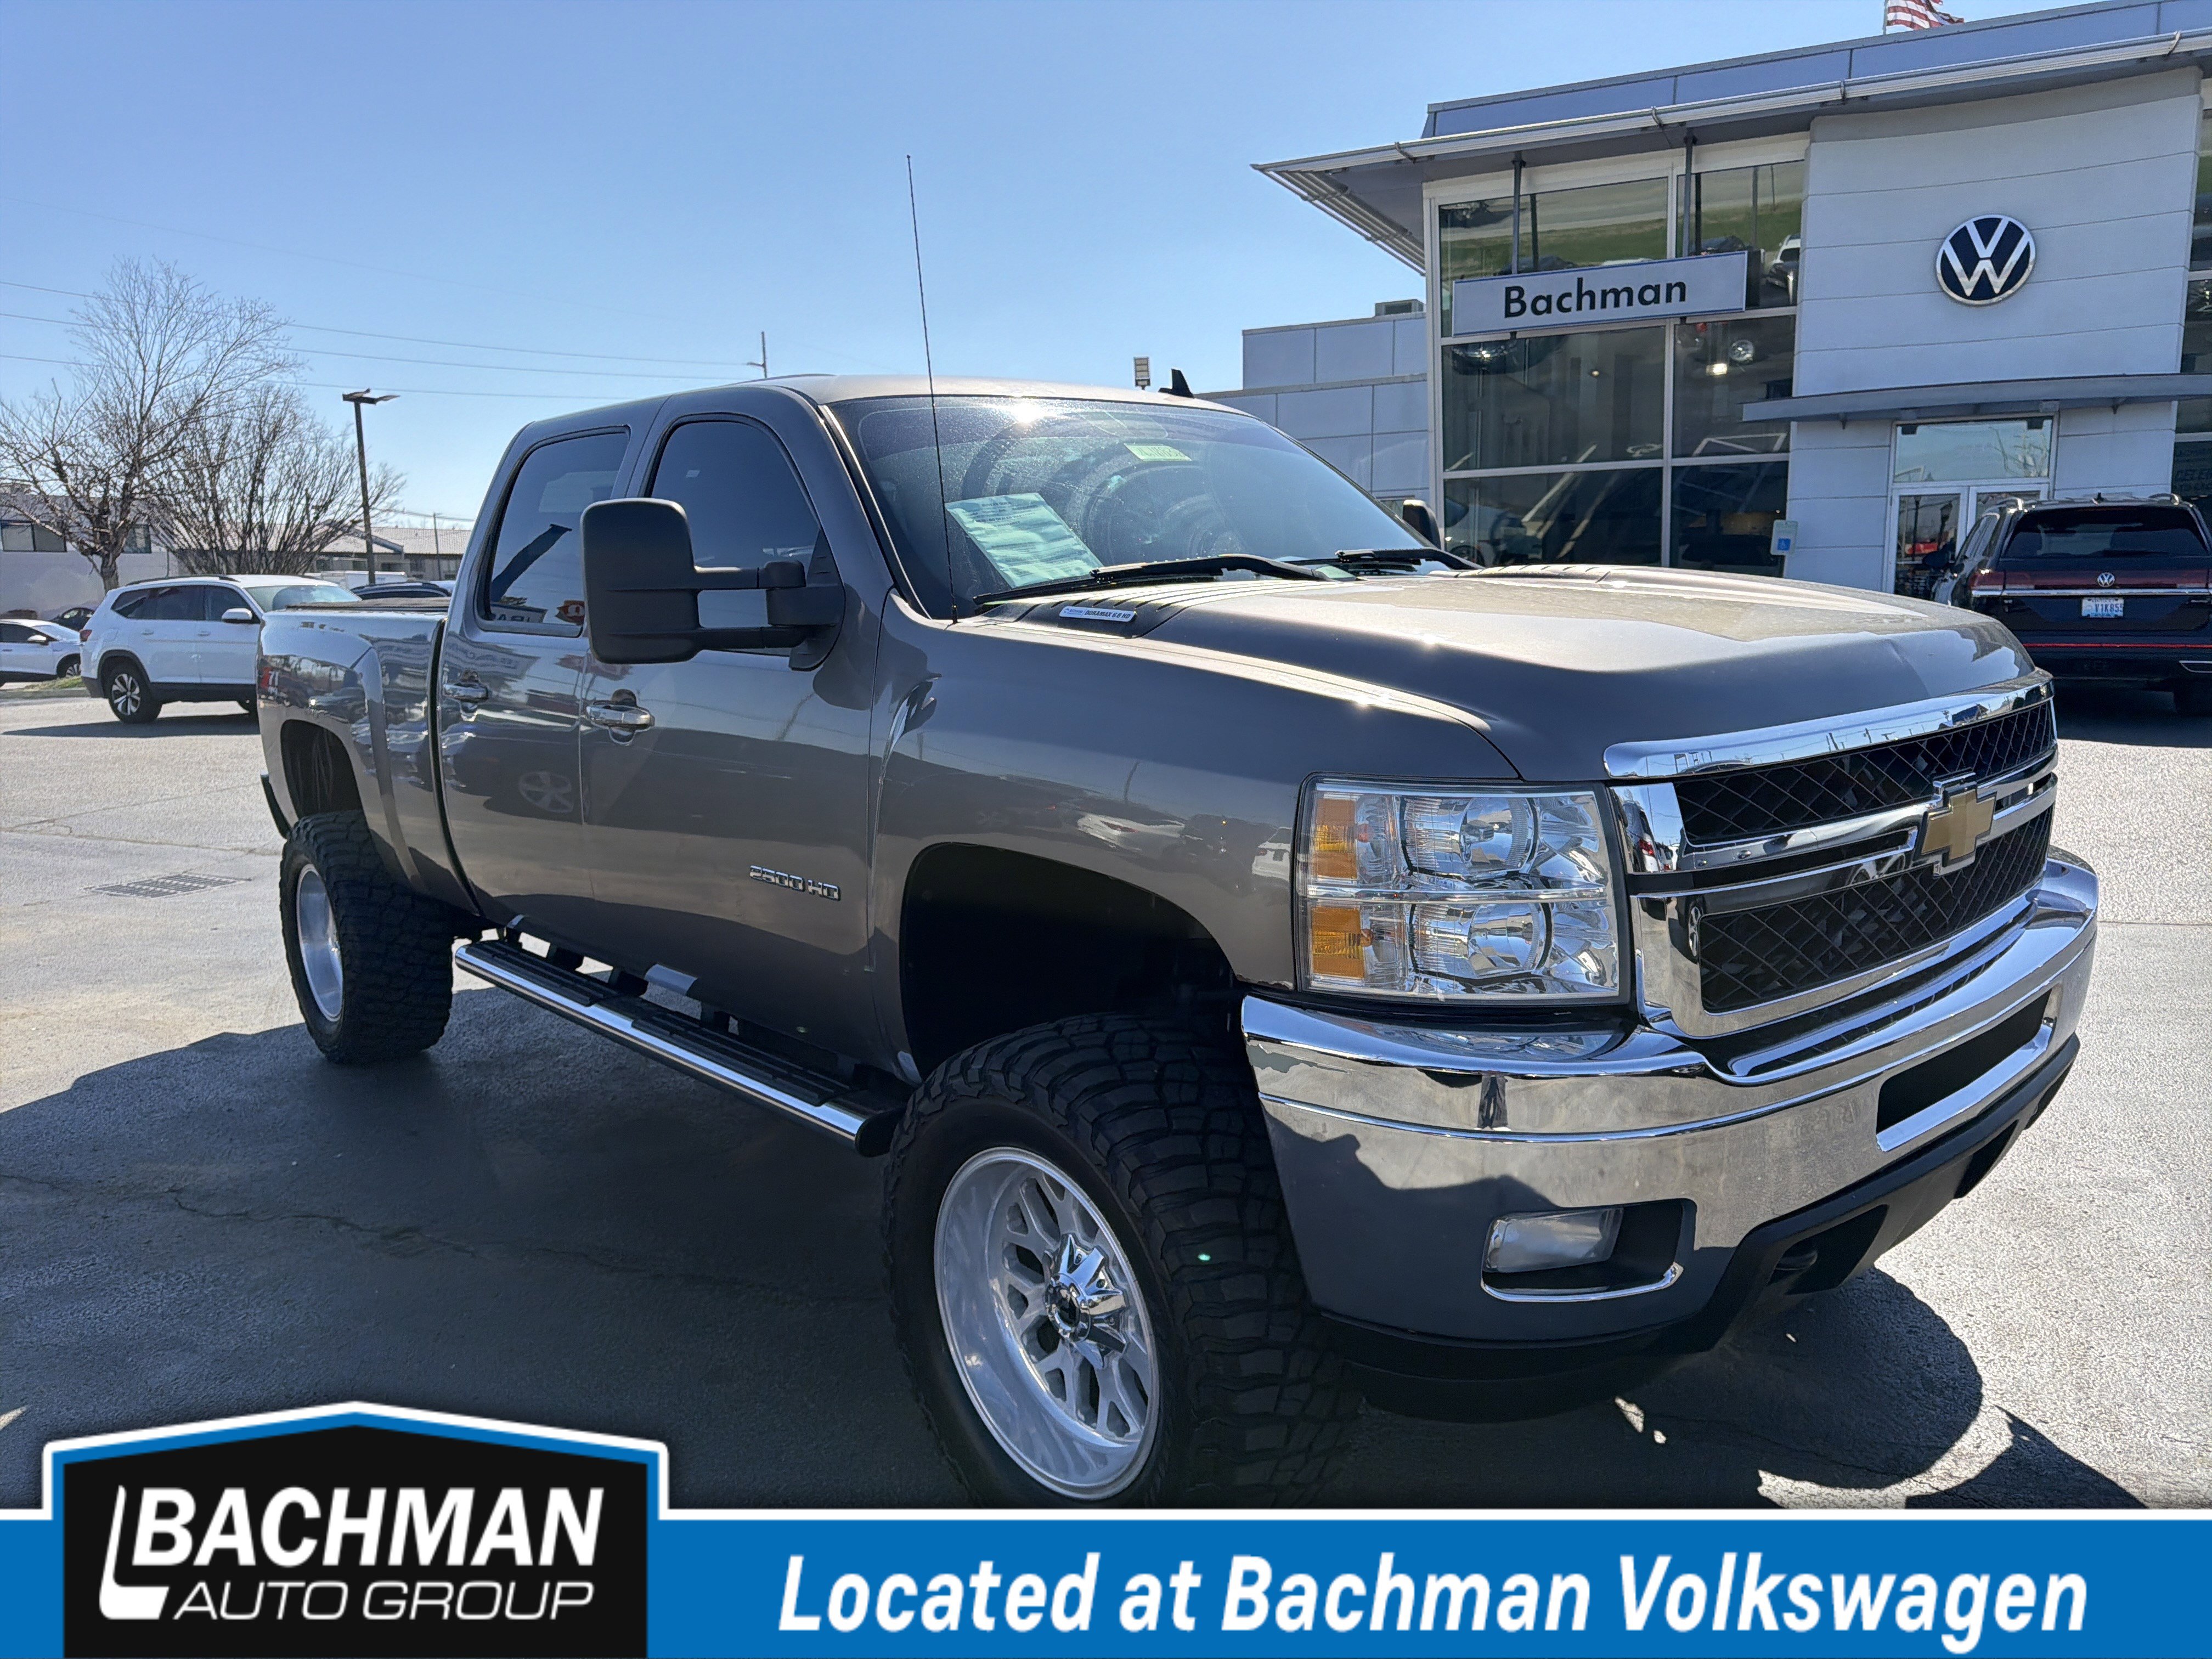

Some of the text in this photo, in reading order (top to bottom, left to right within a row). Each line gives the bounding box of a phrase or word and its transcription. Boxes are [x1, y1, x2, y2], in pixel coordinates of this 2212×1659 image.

[1504, 277, 1686, 319] Bachman
[749, 865, 841, 901] 2500 HD
